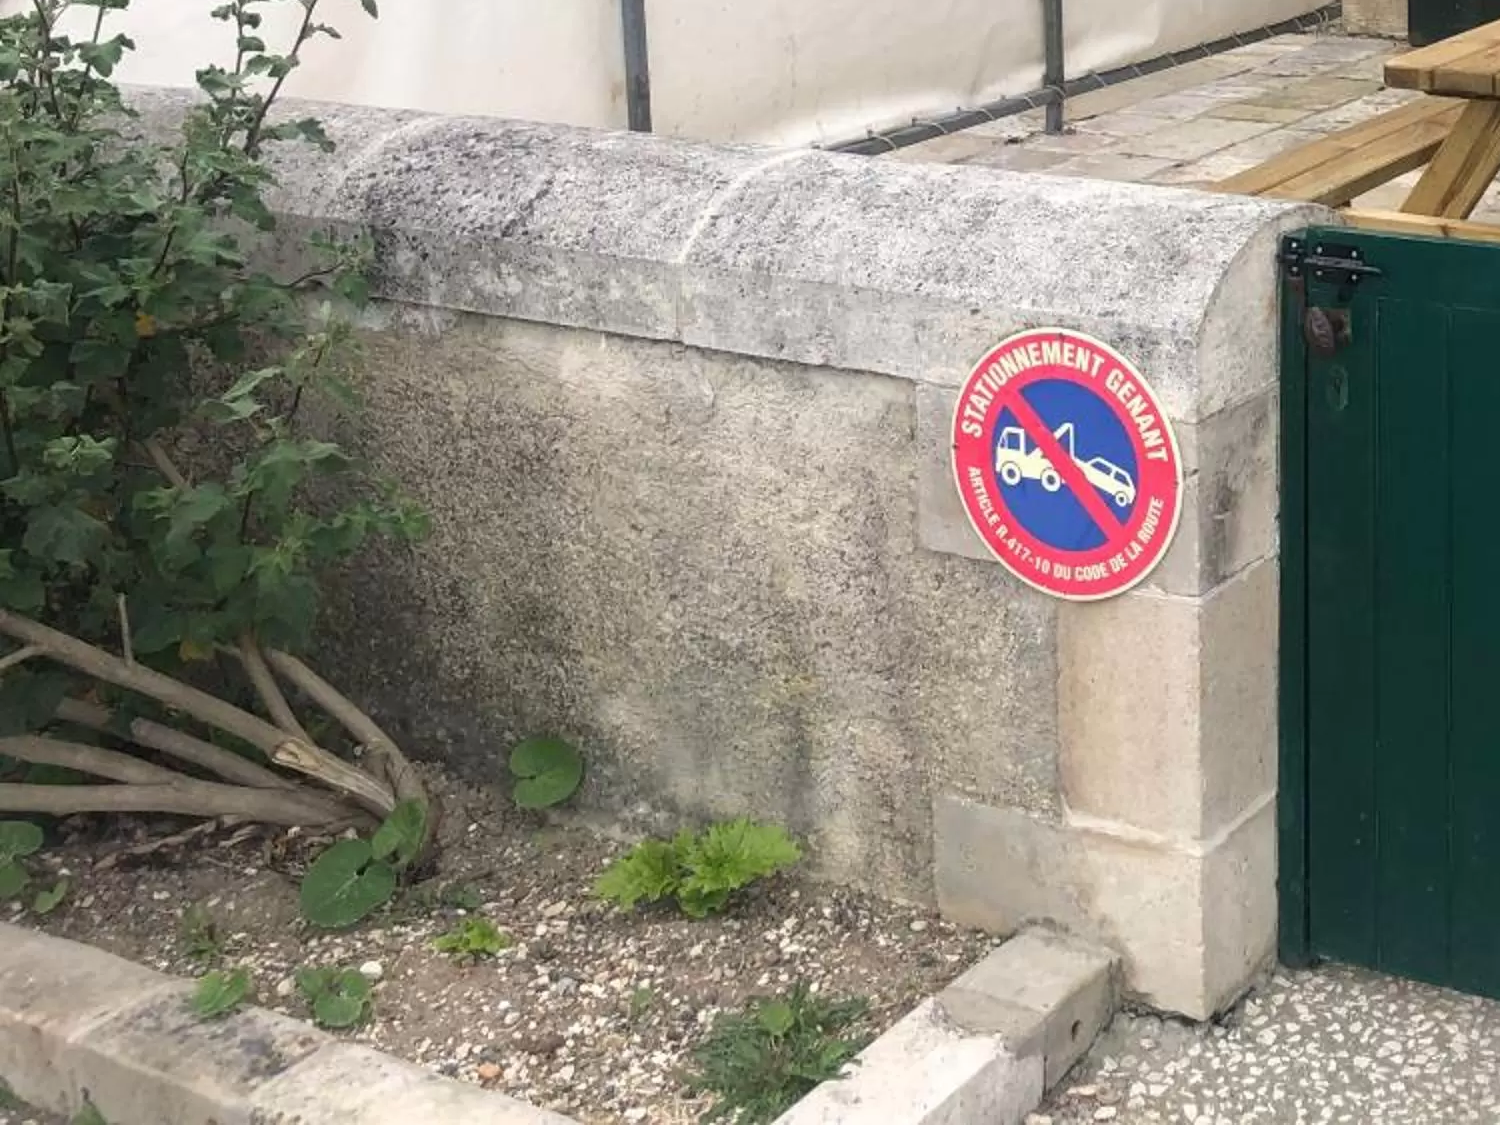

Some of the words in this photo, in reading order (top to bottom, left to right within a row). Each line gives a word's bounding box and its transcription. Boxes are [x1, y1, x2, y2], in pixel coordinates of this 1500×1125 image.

[961, 340, 1105, 438] STATIONNEMENT
[1104, 368, 1168, 462] GENANT
[968, 466, 1000, 529] ARTICLE
[996, 523, 1051, 574] R.417-10
[1053, 563, 1072, 581] DU
[1074, 563, 1108, 582] CODE
[1111, 554, 1128, 573] DE
[1124, 540, 1144, 561] LA
[1139, 495, 1165, 540] ROUTE
